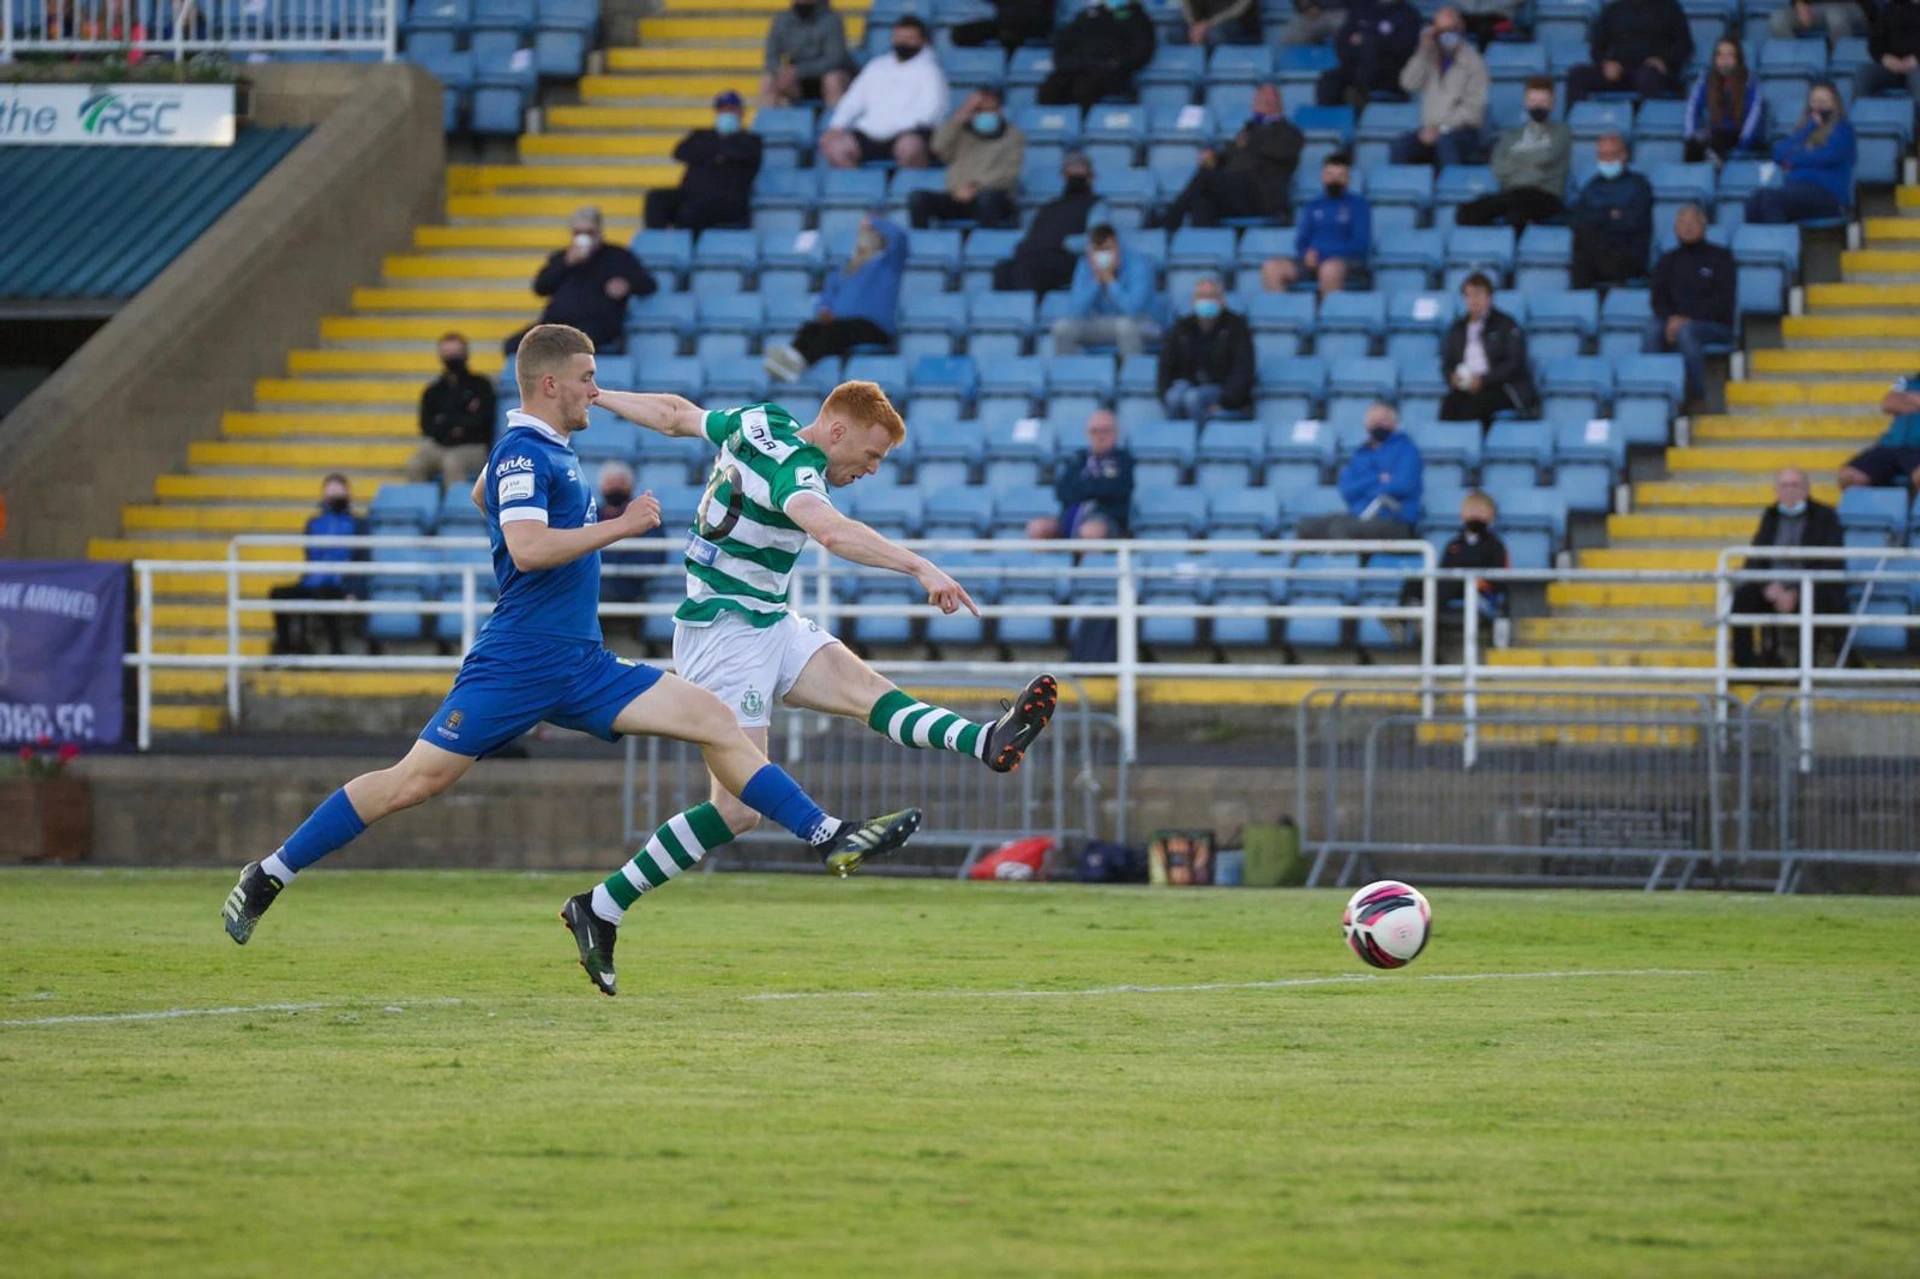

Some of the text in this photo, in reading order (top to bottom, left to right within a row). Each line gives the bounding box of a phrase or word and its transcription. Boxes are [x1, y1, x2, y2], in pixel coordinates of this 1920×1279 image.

[0, 98, 183, 135] the RSC
[23, 583, 98, 620] ARRIVED
[56, 703, 95, 741] FC
